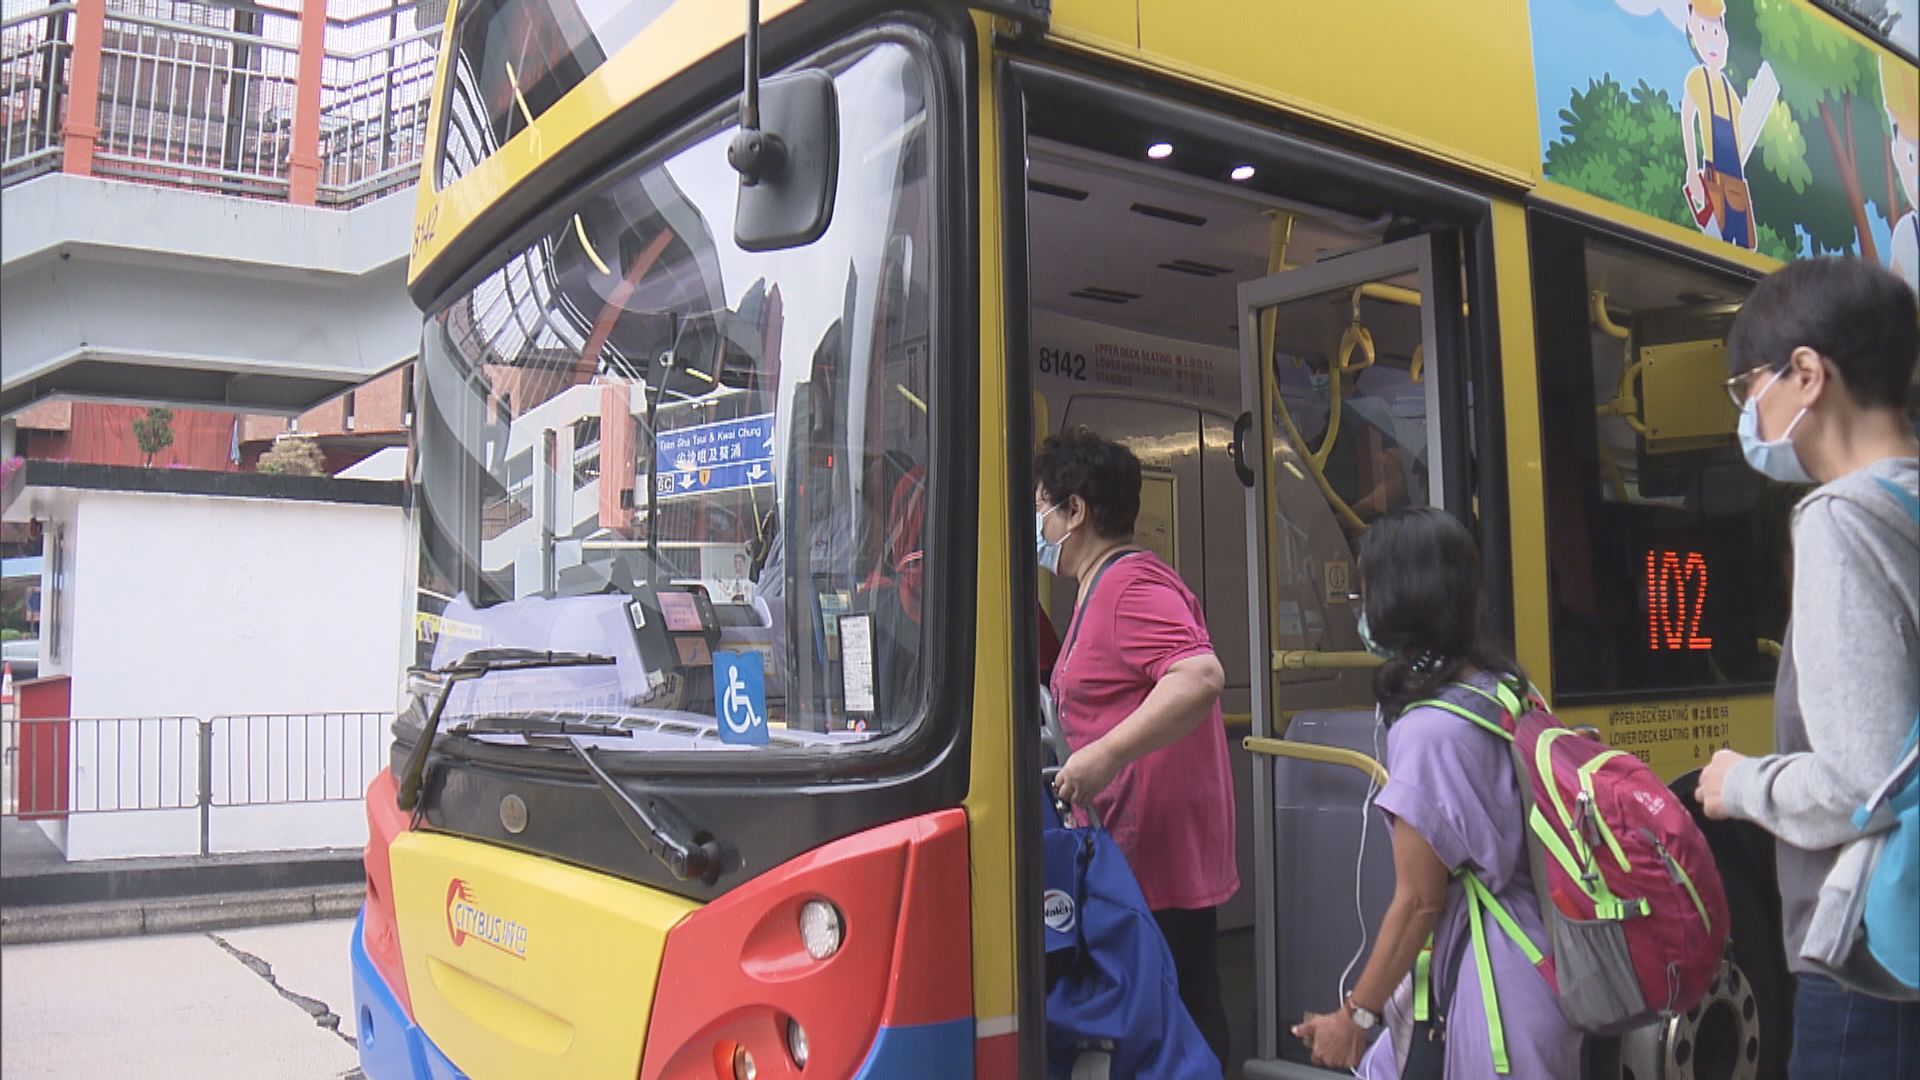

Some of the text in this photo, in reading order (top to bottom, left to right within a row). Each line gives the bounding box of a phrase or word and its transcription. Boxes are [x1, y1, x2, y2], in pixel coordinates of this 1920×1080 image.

[1039, 347, 1087, 381] 8142
[1094, 343, 1172, 365] UPPER DECK SEATING
[1095, 357, 1172, 378] LOWER DECK SEATING
[677, 437, 690, 448] Sha
[693, 434, 706, 446] Tsui
[718, 429, 736, 441] Kwai
[738, 426, 761, 438] Chung
[1647, 550, 1711, 649] 102
[1609, 706, 1688, 726] UPPER DECK SEATING
[1610, 726, 1689, 746] LOWER DECK SEATING
[455, 903, 502, 944] CITYBUS
